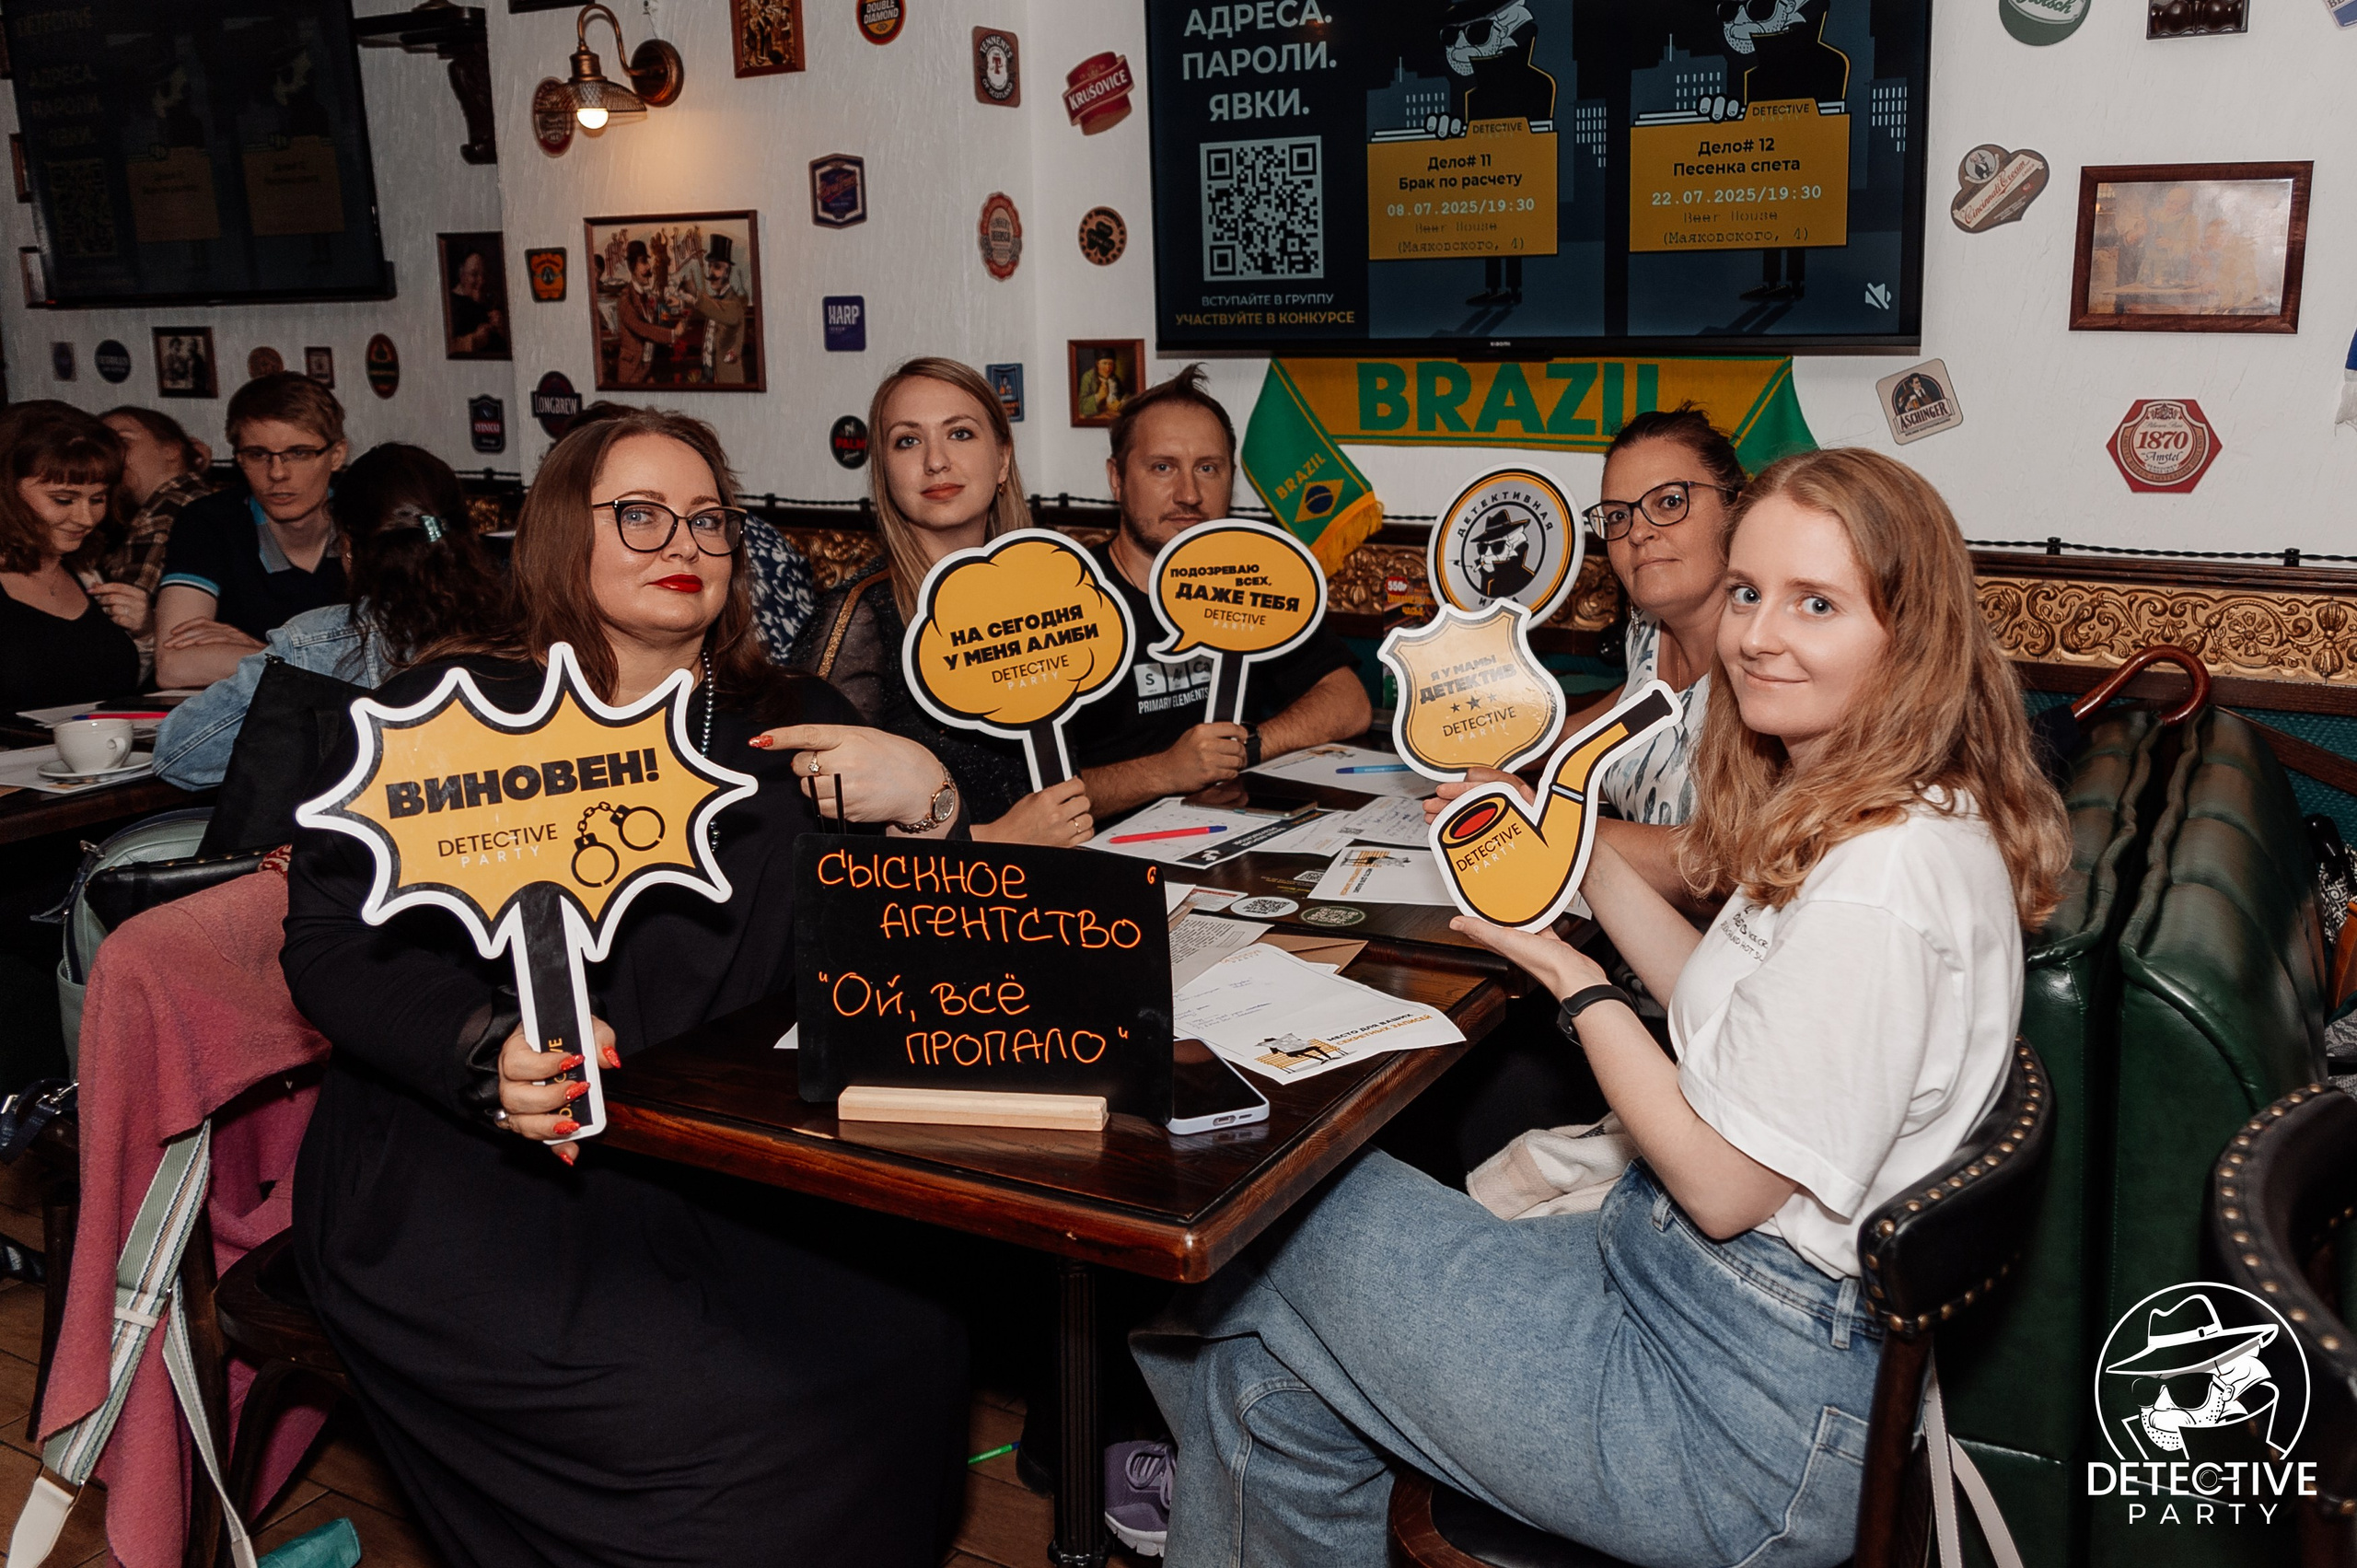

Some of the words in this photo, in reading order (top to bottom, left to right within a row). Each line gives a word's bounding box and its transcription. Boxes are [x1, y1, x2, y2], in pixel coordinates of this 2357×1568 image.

[864, 7, 900, 25] DIAMOND
[866, 0, 895, 13] DOUBLE
[1183, 0, 1333, 40] АДРЕСА.
[1182, 41, 1337, 80] ПАРОЛИ.
[1068, 69, 1128, 110] KRUŠOVICE
[1209, 87, 1310, 122] ЯВКИ.
[1752, 103, 1810, 117] DETECTIVE
[1472, 122, 1523, 134] DETECTIVE
[1698, 139, 1754, 157] Дело#
[1759, 137, 1775, 151] 12
[1427, 156, 1477, 172] Дело#
[1480, 154, 1492, 167] 11
[1673, 161, 1746, 177] Песенка
[1751, 158, 1801, 173] спета
[1399, 177, 1435, 192] Брак
[1439, 178, 1457, 188] по
[1461, 172, 1523, 190] расчету
[1652, 185, 1822, 206] 22.07.2025/19:30
[1387, 197, 1535, 217] 08.07.2025/19:30
[1202, 293, 1271, 307] ВСТУПАЙТЕ
[1274, 295, 1283, 305] В
[1285, 293, 1334, 305] ГРУППУ
[828, 305, 860, 325] HARP
[1175, 310, 1262, 325] УЧАСТВУЙТЕ
[1266, 313, 1275, 323] В
[1279, 310, 1355, 323] КОНКУРСЕ
[534, 394, 578, 415] LONGBREW
[1899, 401, 1949, 431] ASCHINGER
[2135, 431, 2189, 450] 1870
[2142, 451, 2184, 465] Amstel
[1274, 453, 1326, 500] BRAZIL
[1457, 491, 1554, 539] ДЕТЕКТИВНАЯ
[1170, 563, 1260, 577] ПОДОЗРЕВАЮ
[1235, 576, 1272, 587] ВСЕХ,
[1175, 582, 1245, 605] ДАЖЕ
[1249, 591, 1300, 612] ТЕБЯ
[950, 626, 984, 647] НА
[986, 604, 1084, 638] СЕГОДНЯ
[1203, 608, 1267, 625] DETECTIVE
[1213, 619, 1256, 633] PARTY
[943, 654, 960, 671] У
[963, 640, 1022, 668] МЕНЯ
[1027, 622, 1099, 654] АЛИБИ
[992, 654, 1070, 683] DETECTIVE
[1430, 670, 1440, 681] Я
[1441, 668, 1451, 679] У
[1453, 655, 1497, 675] МАМЫ
[1007, 671, 1060, 691] PARTY
[1144, 673, 1155, 686] S
[1419, 663, 1517, 705] ДЕТЕКТИВ
[1138, 695, 1171, 714] PRIMARY
[1172, 686, 1210, 708] ELEMENTS
[1443, 706, 1517, 737] DETECTIVE
[1458, 722, 1508, 742] PARTY
[385, 747, 660, 819] ВИНОВЕН!
[437, 823, 558, 857] DETECTIVE
[1456, 822, 1523, 872] DETECTIVE
[460, 844, 540, 868] PARTY
[1473, 841, 1516, 875] PARTY
